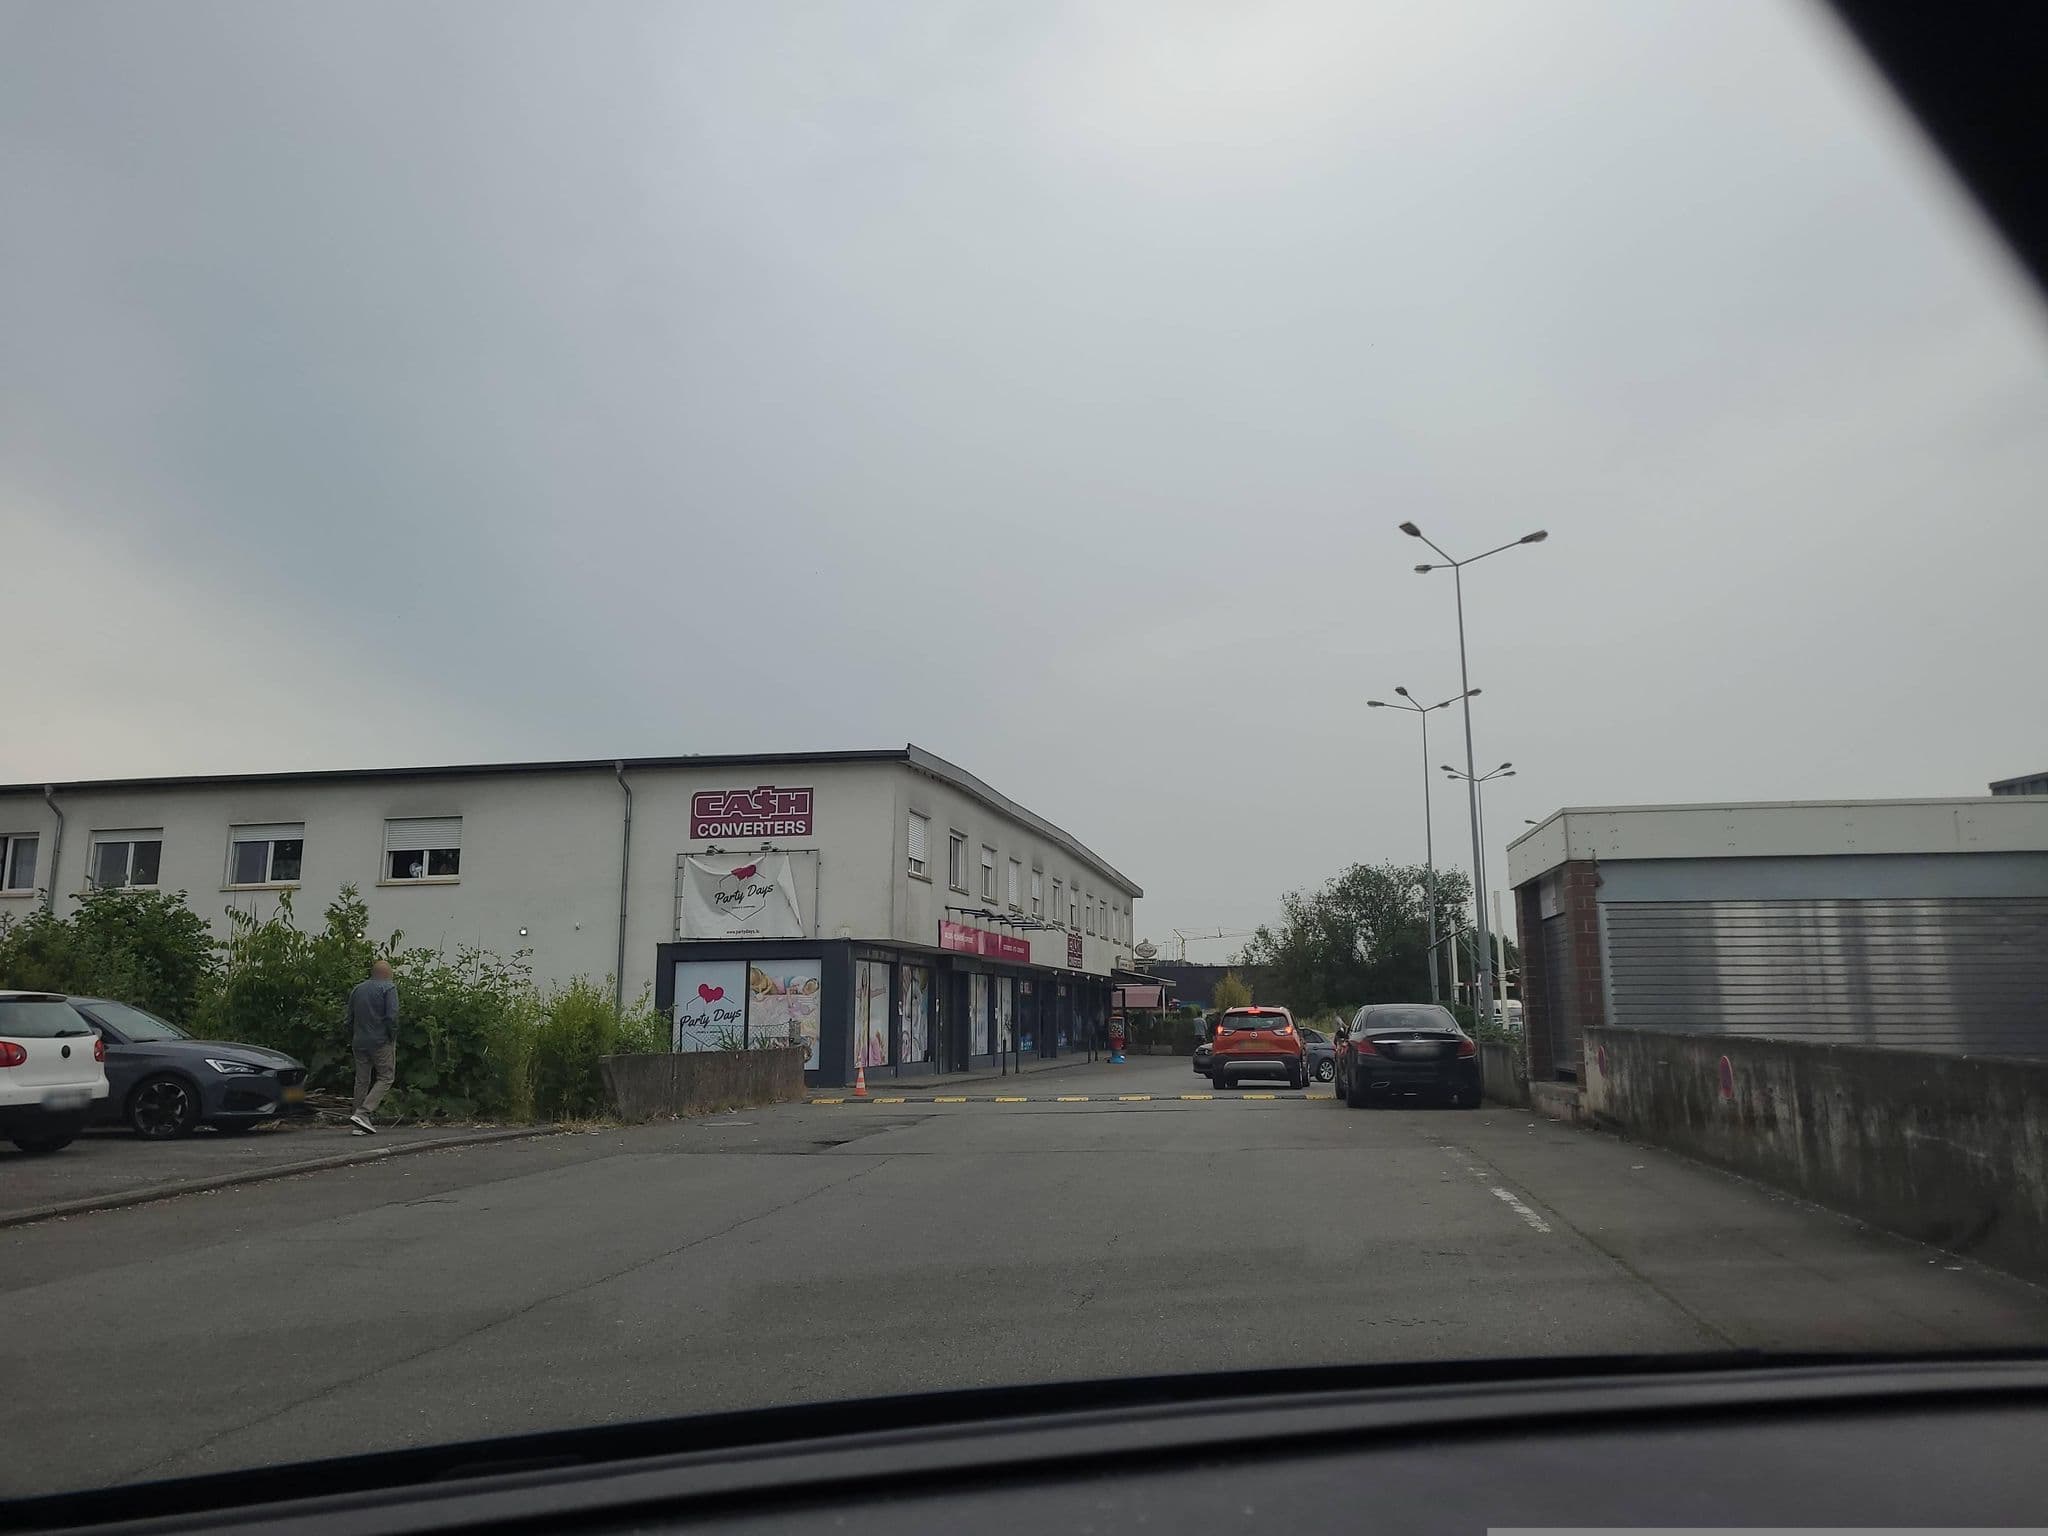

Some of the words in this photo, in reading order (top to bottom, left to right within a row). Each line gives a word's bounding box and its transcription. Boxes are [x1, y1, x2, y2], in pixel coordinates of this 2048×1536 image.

[697, 820, 806, 836] CONVERTERS
[714, 889, 744, 904] Party
[747, 884, 774, 898] Days
[680, 1012, 710, 1028] Party
[713, 1009, 742, 1022] Days
